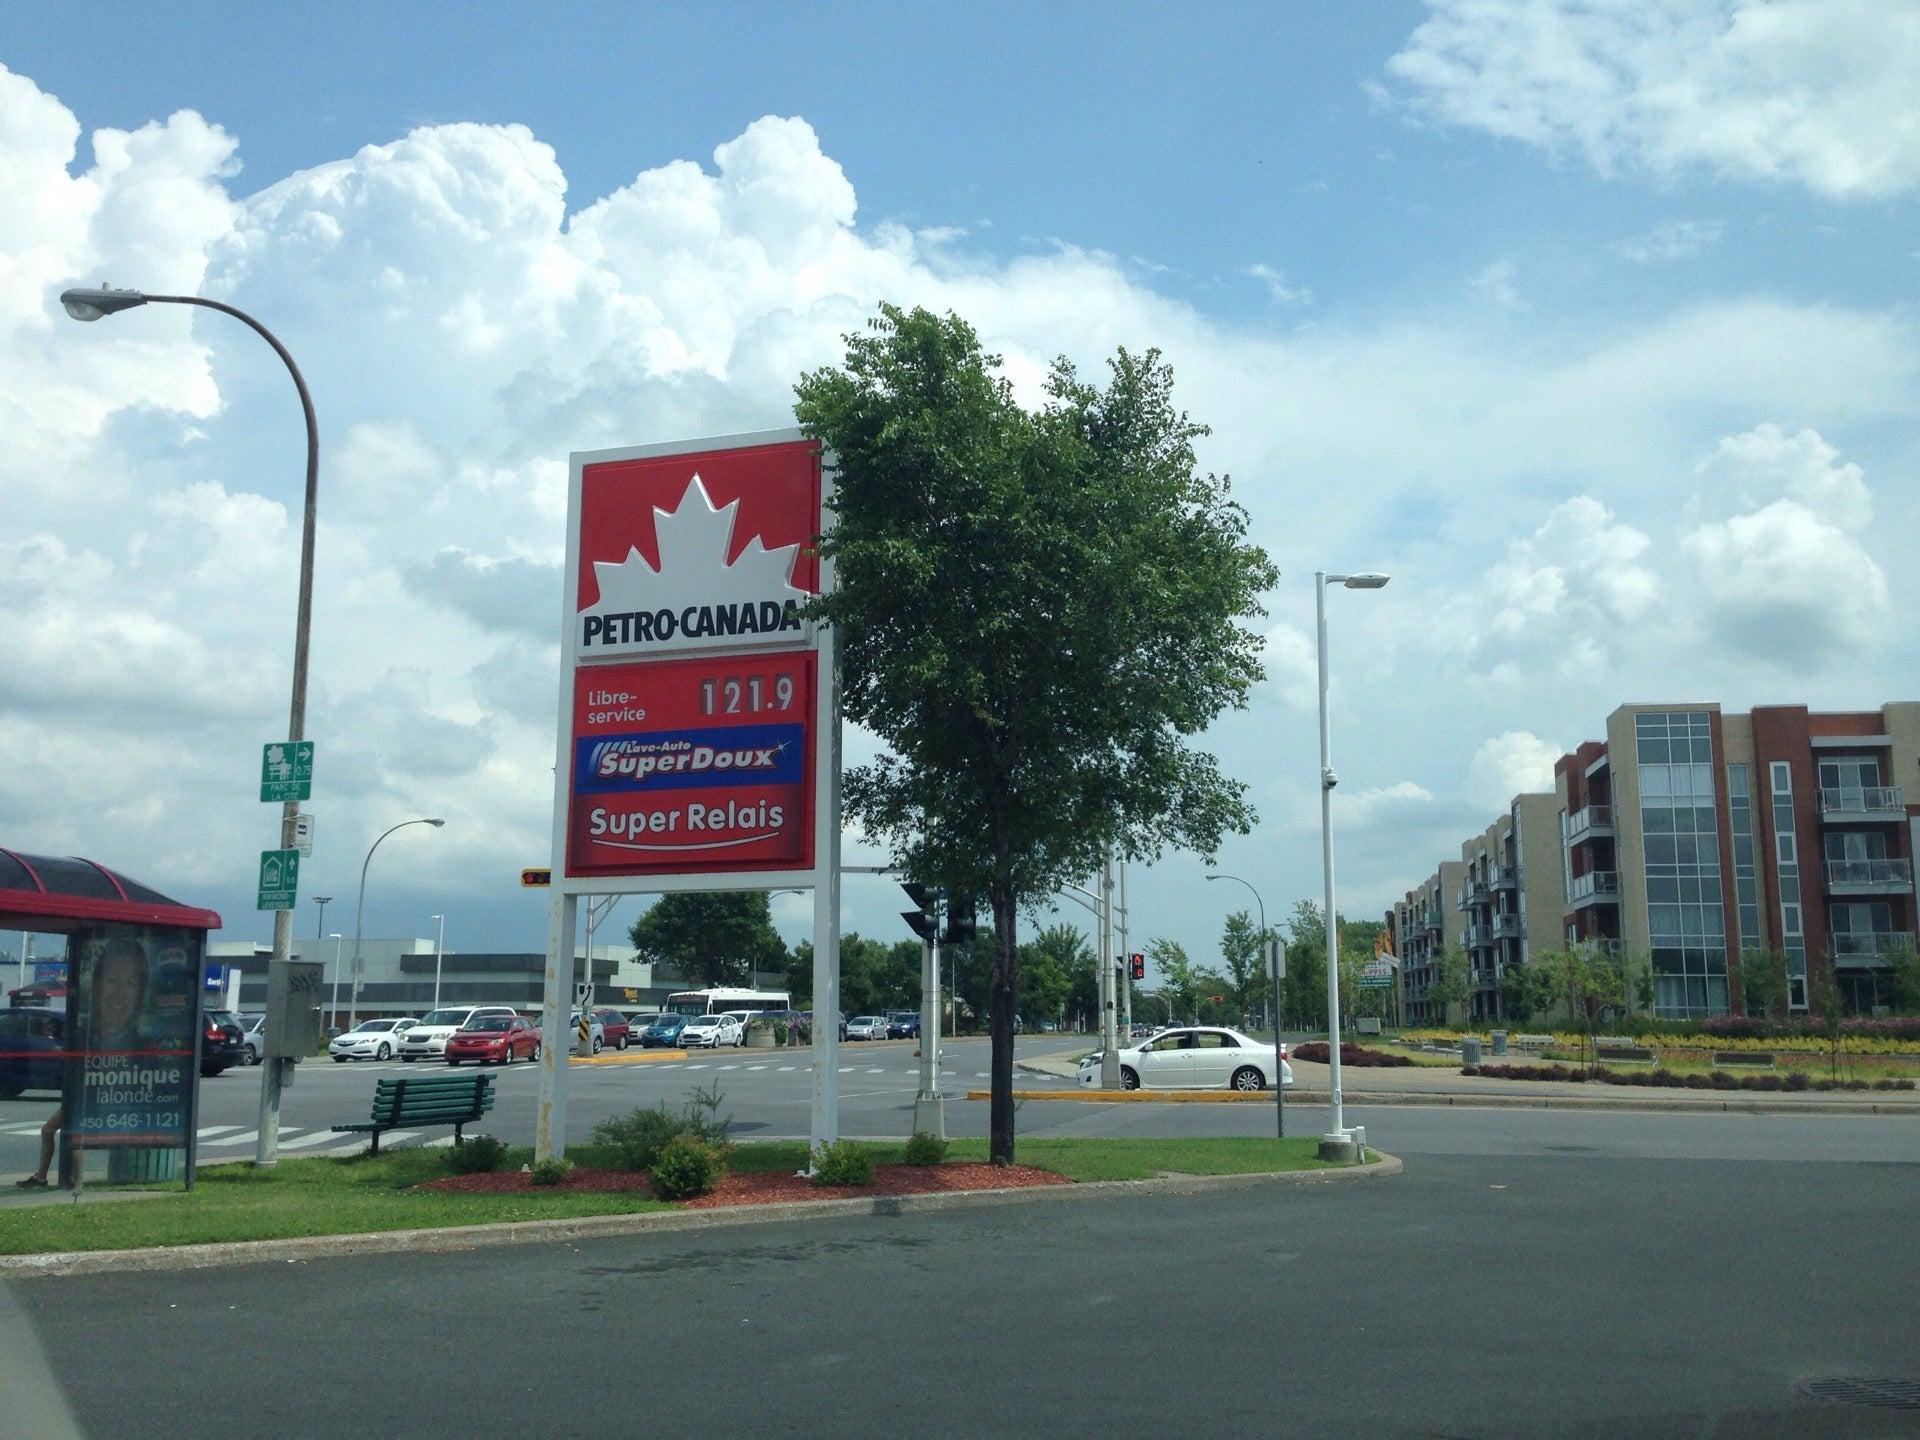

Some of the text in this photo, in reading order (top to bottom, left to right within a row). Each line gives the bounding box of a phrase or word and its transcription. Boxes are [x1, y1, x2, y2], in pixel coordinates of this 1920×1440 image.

[583, 599, 801, 647] PETRO-CANADA
[588, 690, 638, 706] Libre-
[702, 677, 793, 715] 121.9
[588, 707, 646, 724] service
[590, 800, 785, 841] Super Relais
[84, 1065, 181, 1091] monique
[80, 1112, 180, 1129] 450 646-1121
